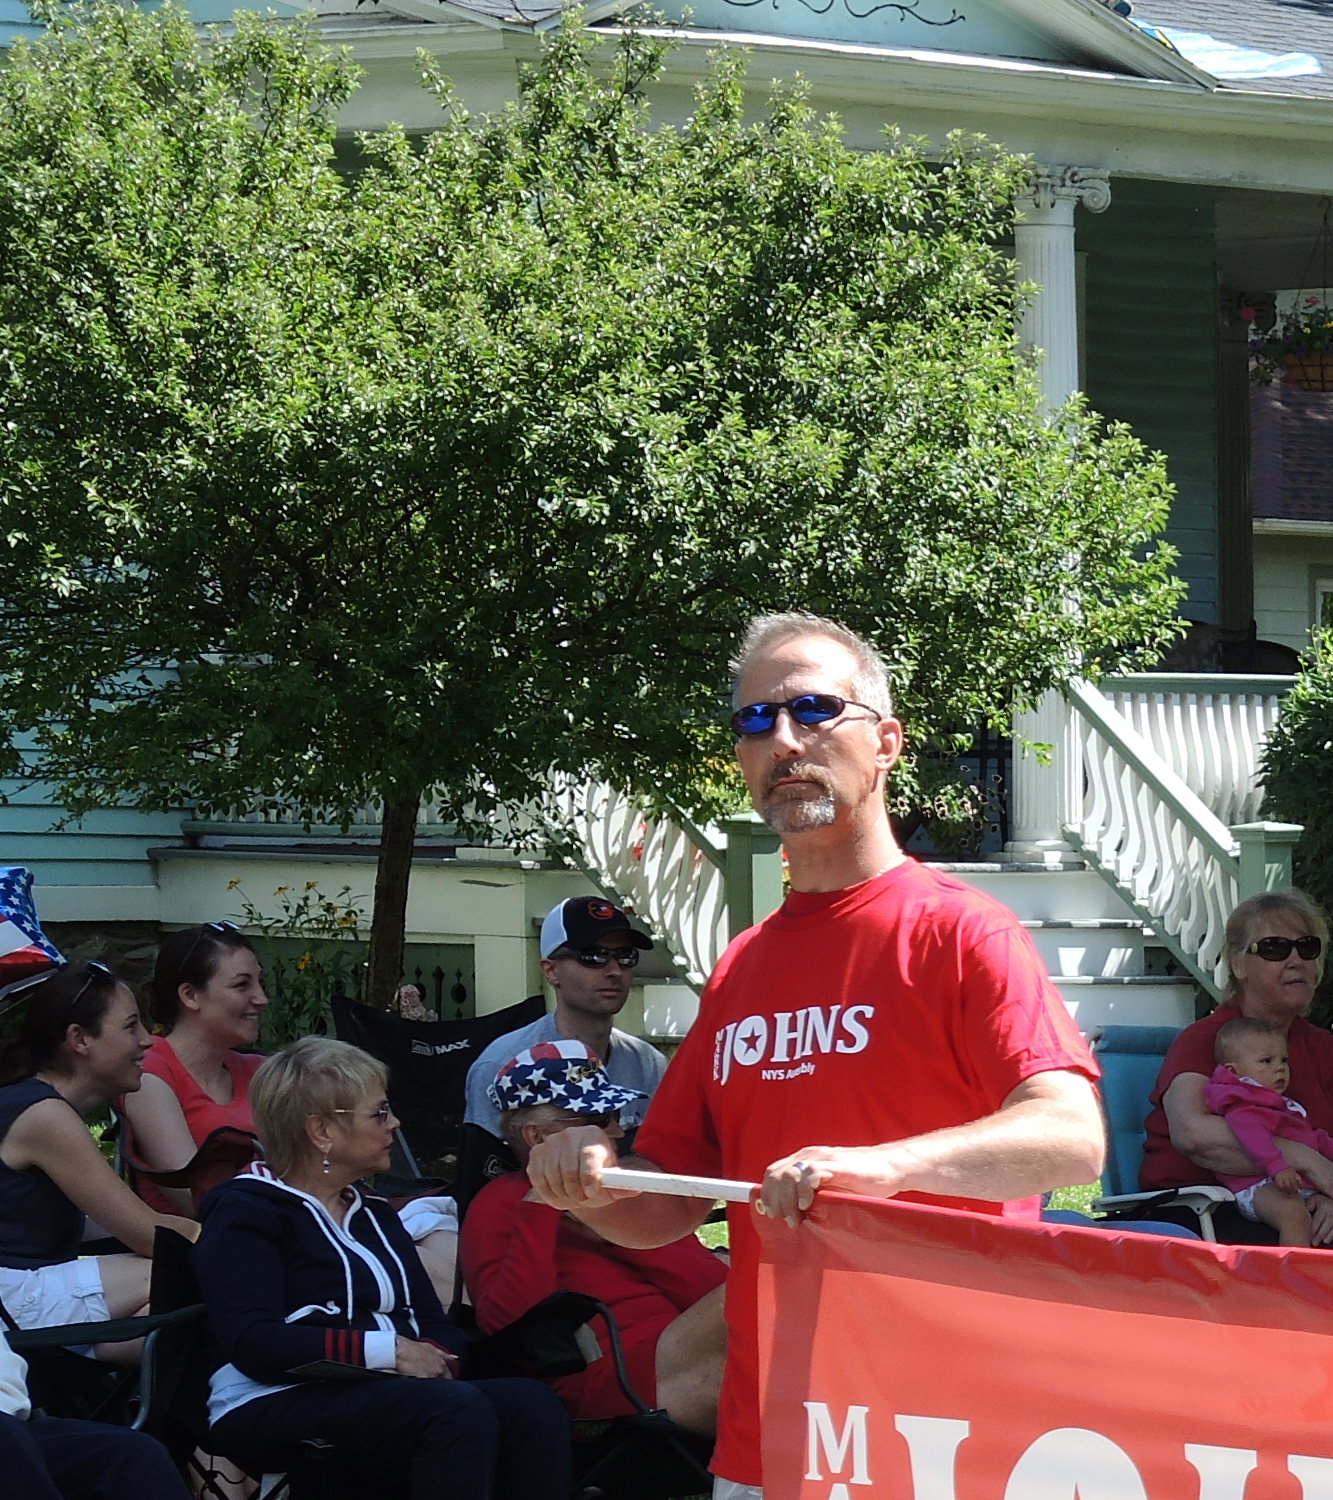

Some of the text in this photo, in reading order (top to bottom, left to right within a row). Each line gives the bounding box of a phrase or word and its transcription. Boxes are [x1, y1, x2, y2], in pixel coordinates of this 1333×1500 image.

[435, 1039, 471, 1055] MAX
[720, 1005, 875, 1086] JOHNS
[761, 1061, 816, 1080] NYS Ably
